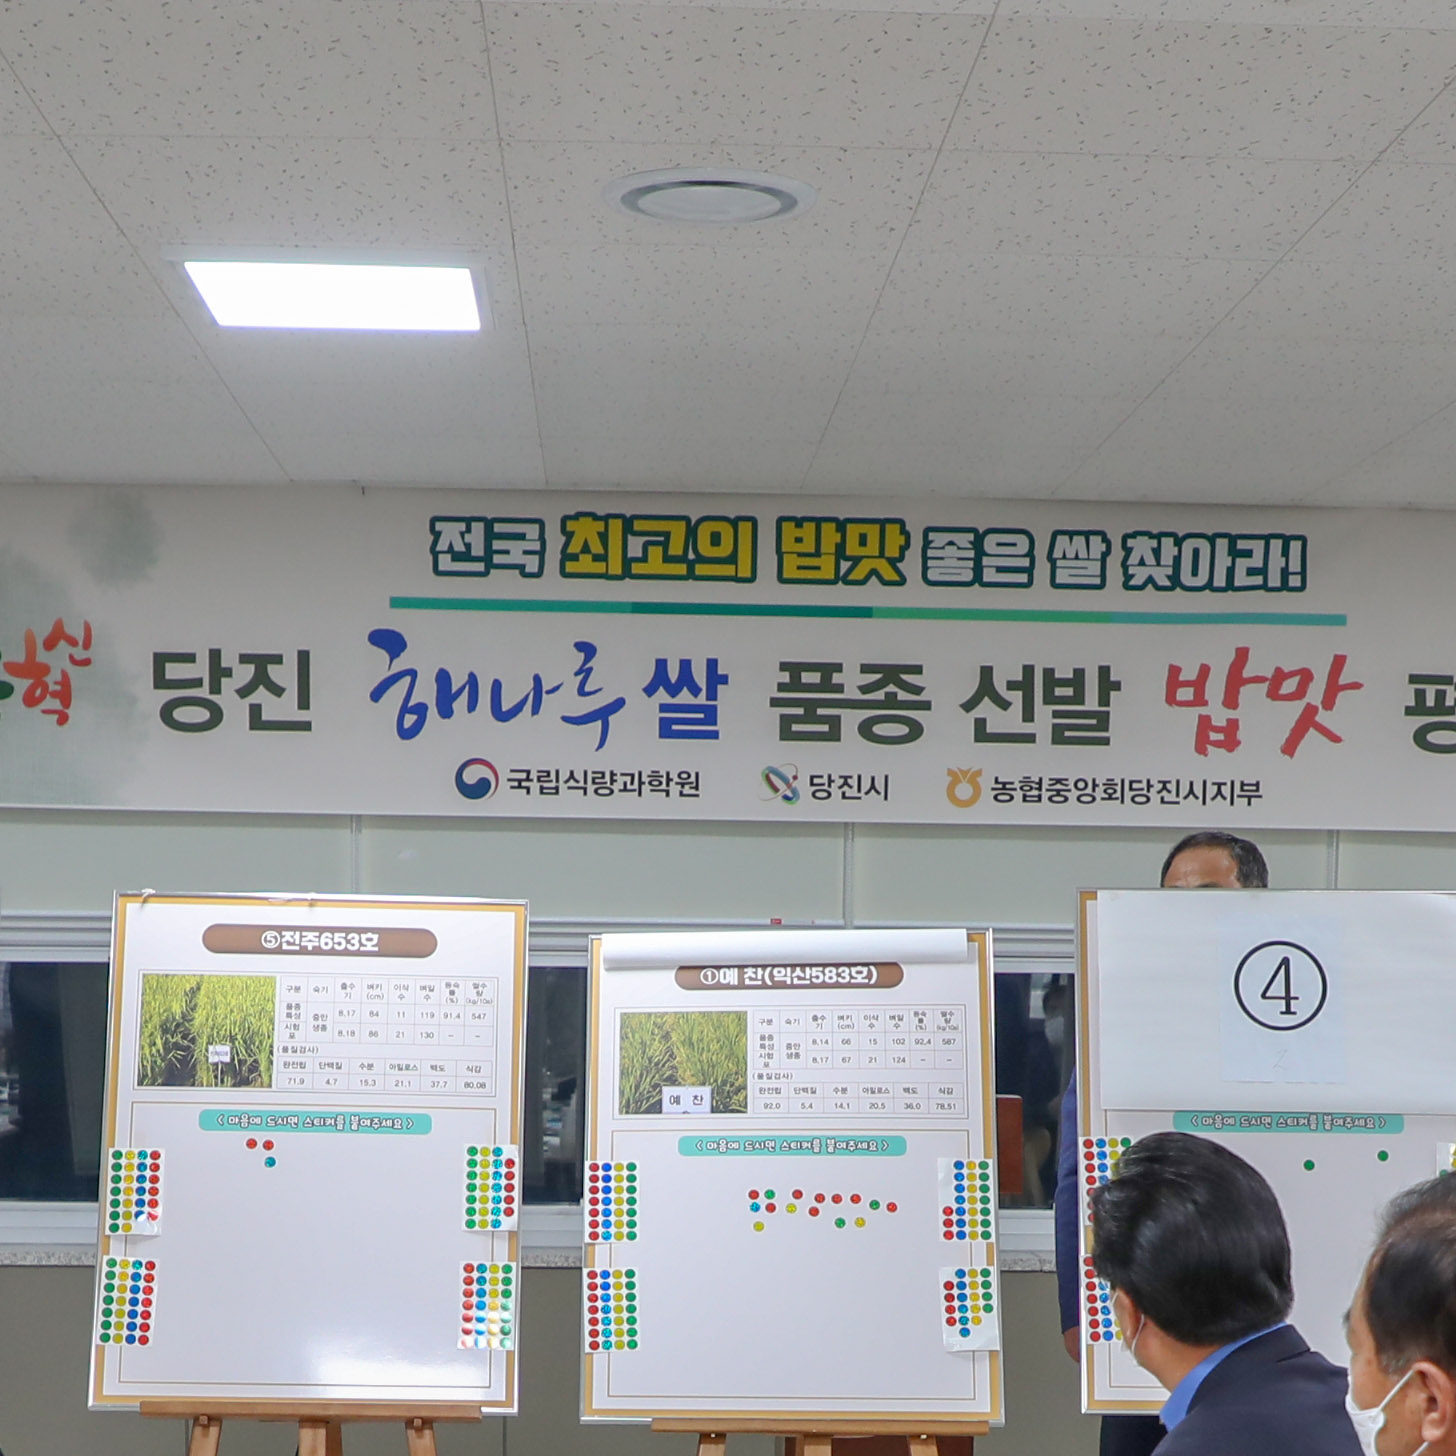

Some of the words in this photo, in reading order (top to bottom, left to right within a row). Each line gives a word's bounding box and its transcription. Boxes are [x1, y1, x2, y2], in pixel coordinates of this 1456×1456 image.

[429, 516, 545, 578] 전국
[559, 512, 758, 580] 최고의
[776, 516, 909, 586] 밥맛
[922, 527, 1034, 588] 좋은
[1048, 530, 1109, 590] 쌀
[1122, 532, 1307, 592] 찾아라!
[152, 647, 313, 733] 당진
[769, 661, 932, 745] 품종
[959, 664, 1122, 746] 선발
[1164, 646, 1364, 759] 밥맛
[507, 769, 700, 797] 국립식량과학원
[809, 773, 890, 801] 당진시
[991, 775, 1263, 806] 농협중앙회당진시지부
[744, 966, 878, 986] 찬(익산583호)
[367, 992, 384, 1000] (cm)
[443, 1012, 460, 1020] 91.4
[360, 1079, 376, 1087] 15.3
[669, 1094, 681, 1105] 예
[228, 1114, 262, 1128] 마음에
[267, 1115, 298, 1127] 드시면
[304, 1116, 344, 1129] 스티커를
[350, 1115, 402, 1130] 붙여주세요
[1202, 1115, 1235, 1128] 마음에
[1240, 1116, 1272, 1127] 드시면
[1277, 1115, 1317, 1129] 스티커를
[1323, 1115, 1375, 1129] 붙여주세요
[706, 1138, 739, 1152] 마음에
[744, 1140, 776, 1151] 드시면
[780, 1138, 821, 1152] 스티커를
[827, 1139, 877, 1152] 붙여주세요
